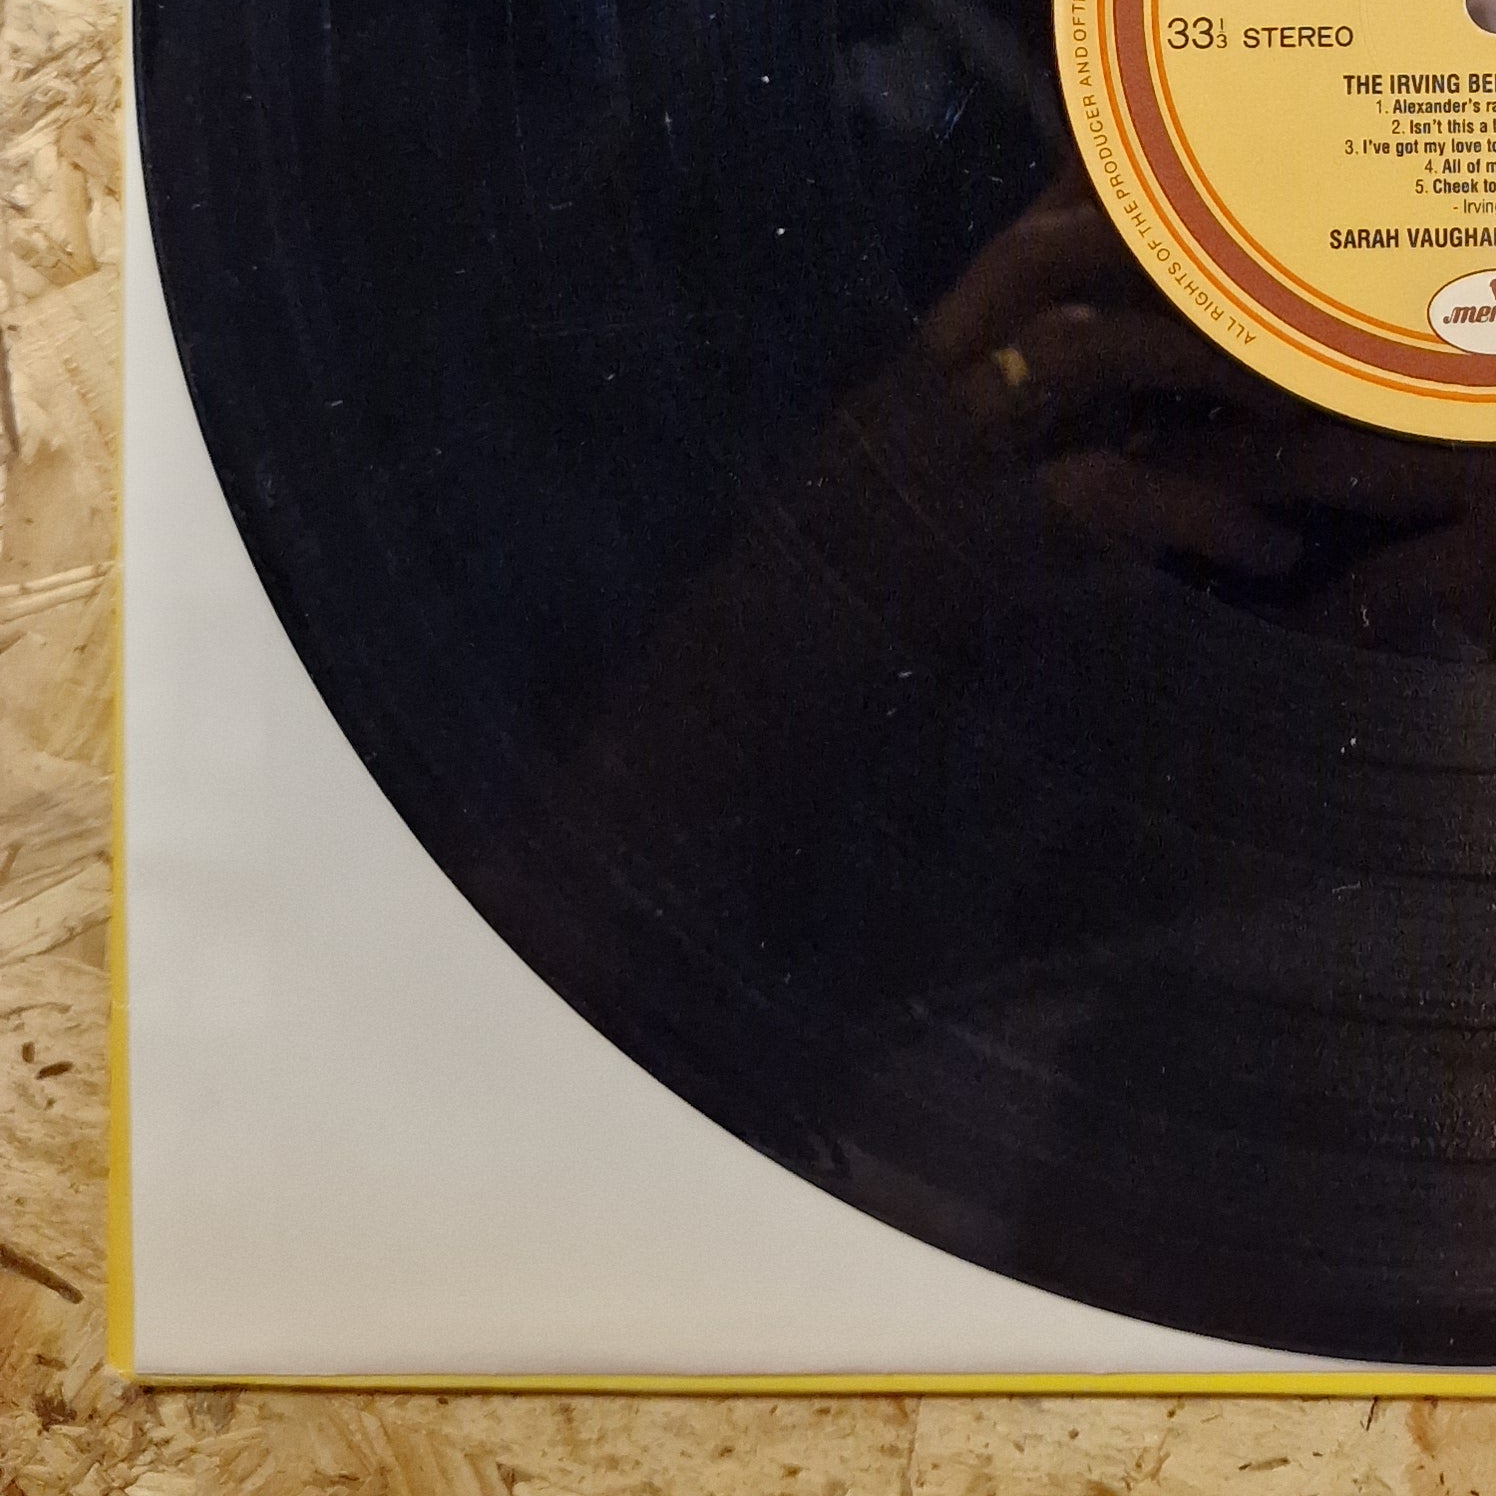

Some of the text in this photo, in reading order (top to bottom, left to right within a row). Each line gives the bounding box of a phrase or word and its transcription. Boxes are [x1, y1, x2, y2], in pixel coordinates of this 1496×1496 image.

[1242, 25, 1354, 49] STEREO
[1073, 45, 1092, 87] AND
[1342, 74, 1384, 96] THE
[1389, 73, 1461, 95] IRVING
[1375, 99, 1389, 115] 1.
[1392, 97, 1481, 115] Alexander's
[1391, 119, 1406, 135] 2.
[1409, 118, 1443, 135] Isn't
[1446, 118, 1475, 135] this
[1479, 121, 1488, 134] a
[1081, 93, 1131, 200] PRODUCER
[1344, 139, 1359, 156] 3.
[1362, 138, 1391, 155] I've
[1395, 138, 1419, 158] got
[1423, 141, 1447, 157] my
[1451, 137, 1482, 154] love
[1423, 158, 1438, 175] 4.
[1441, 158, 1461, 175] All
[1466, 157, 1481, 174] of
[1414, 178, 1429, 195] 5.
[1432, 177, 1479, 195] Cheek
[1482, 178, 1496, 194] to
[1122, 198, 1152, 239] THE
[1146, 238, 1171, 262] OF
[1329, 228, 1400, 250] SARAH
[1166, 260, 1225, 321] RIGHTS
[1226, 315, 1257, 345] ALL
